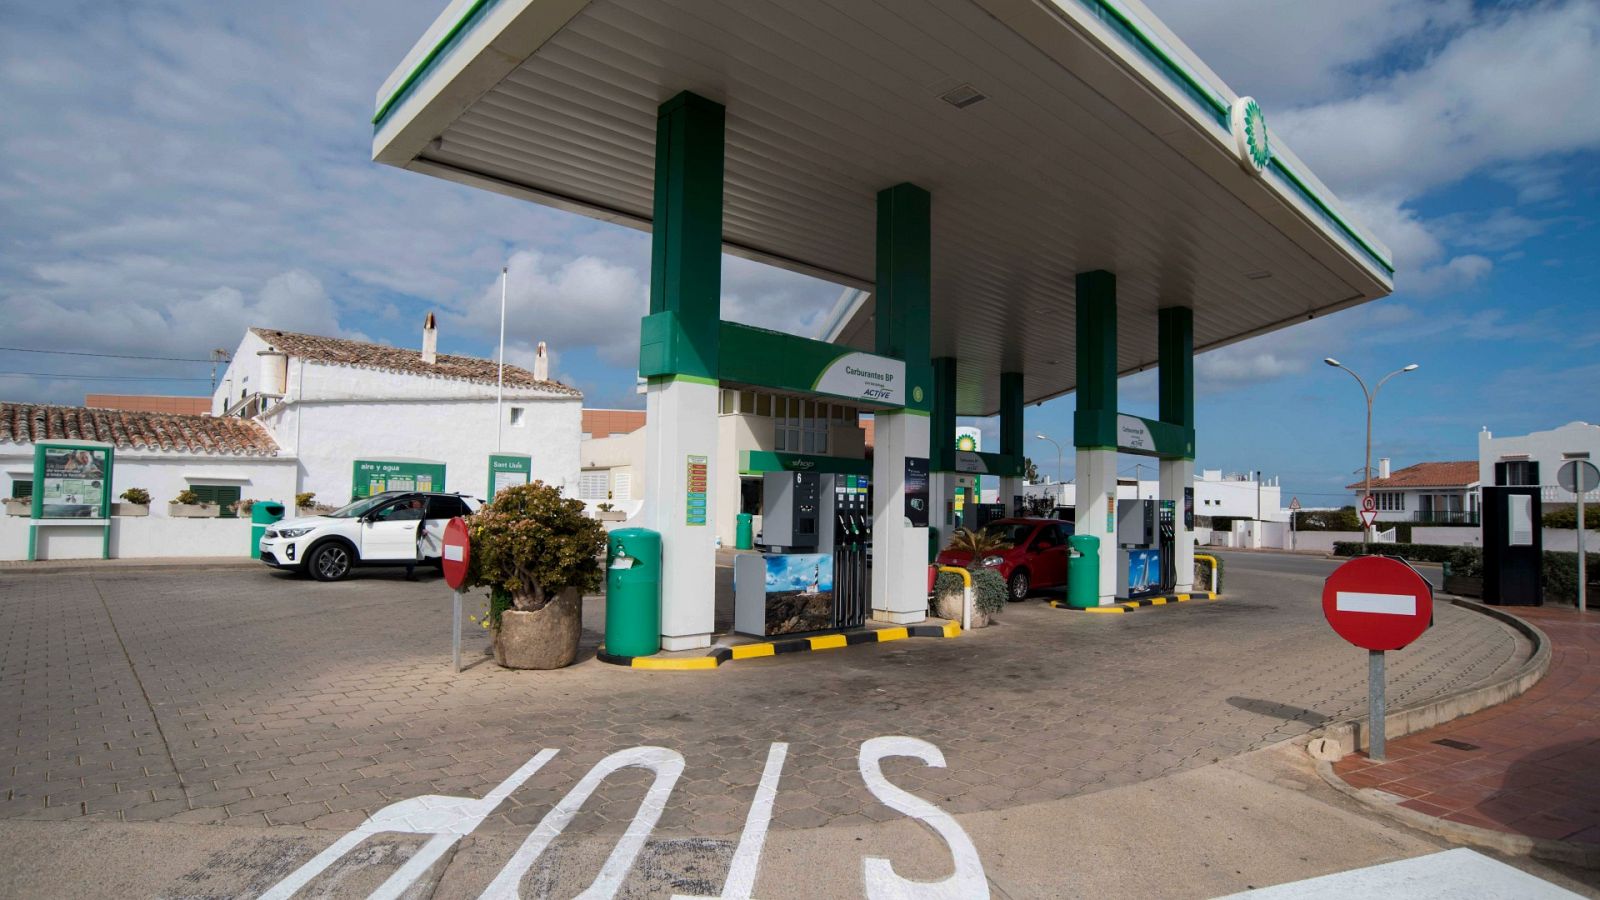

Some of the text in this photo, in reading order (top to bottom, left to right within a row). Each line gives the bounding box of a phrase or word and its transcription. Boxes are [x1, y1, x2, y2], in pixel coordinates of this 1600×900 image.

[845, 366, 894, 382] Carburantes BP
[863, 388, 891, 399] ACTIVE
[493, 461, 508, 469] Sant
[797, 472, 802, 483] 6
